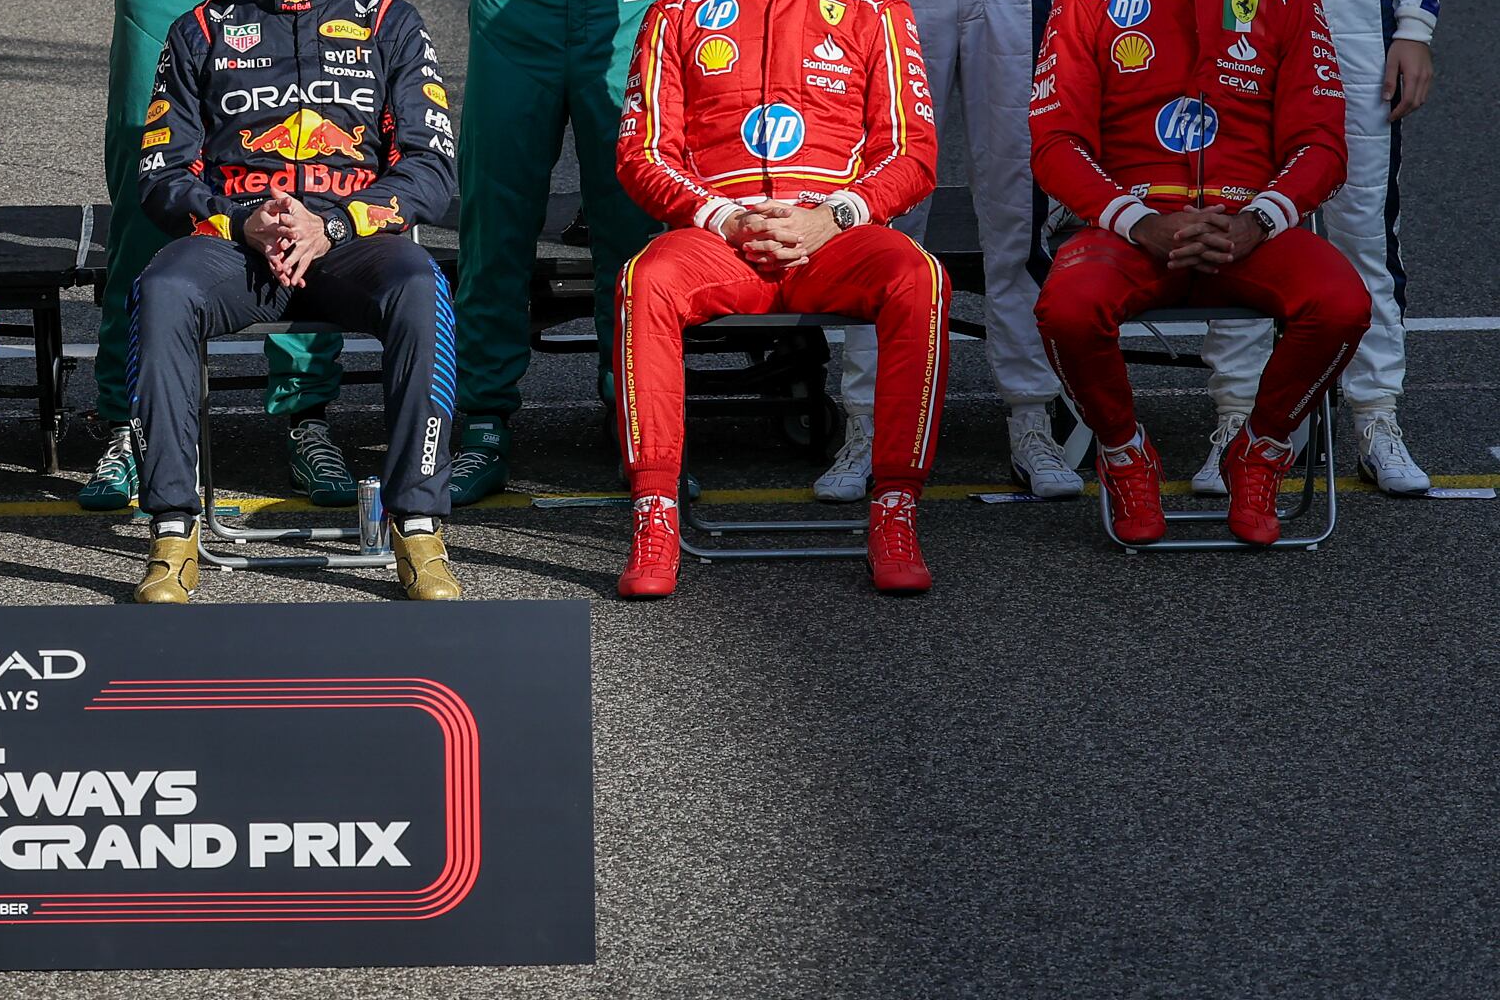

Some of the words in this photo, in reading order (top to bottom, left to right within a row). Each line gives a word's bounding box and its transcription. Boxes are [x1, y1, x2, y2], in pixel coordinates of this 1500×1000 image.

[226, 25, 259, 37] TAG
[333, 24, 367, 38] RAUCH
[225, 35, 261, 52] HEUER
[215, 57, 255, 71] Mobil
[325, 47, 372, 65] BYBIT
[323, 65, 376, 79] HONDA
[803, 59, 852, 75] Santander
[1217, 59, 1265, 75] Santander
[806, 75, 846, 90] CEVA
[1219, 75, 1259, 90] CEVA
[221, 80, 375, 114] ORACLE
[220, 162, 295, 197] Red
[304, 165, 378, 197] Bull
[1130, 183, 1150, 197] 55
[1220, 186, 1258, 195] CARLOS
[924, 308, 937, 385] ACHIEVEMENT
[921, 386, 930, 408] AND
[1289, 393, 1311, 419] PASSION
[1308, 382, 1321, 395] AND
[627, 372, 641, 444] ACHIEVEMENT
[913, 411, 926, 454] PASSION
[421, 416, 442, 476] sparco
[248, 822, 412, 868] PRIX
